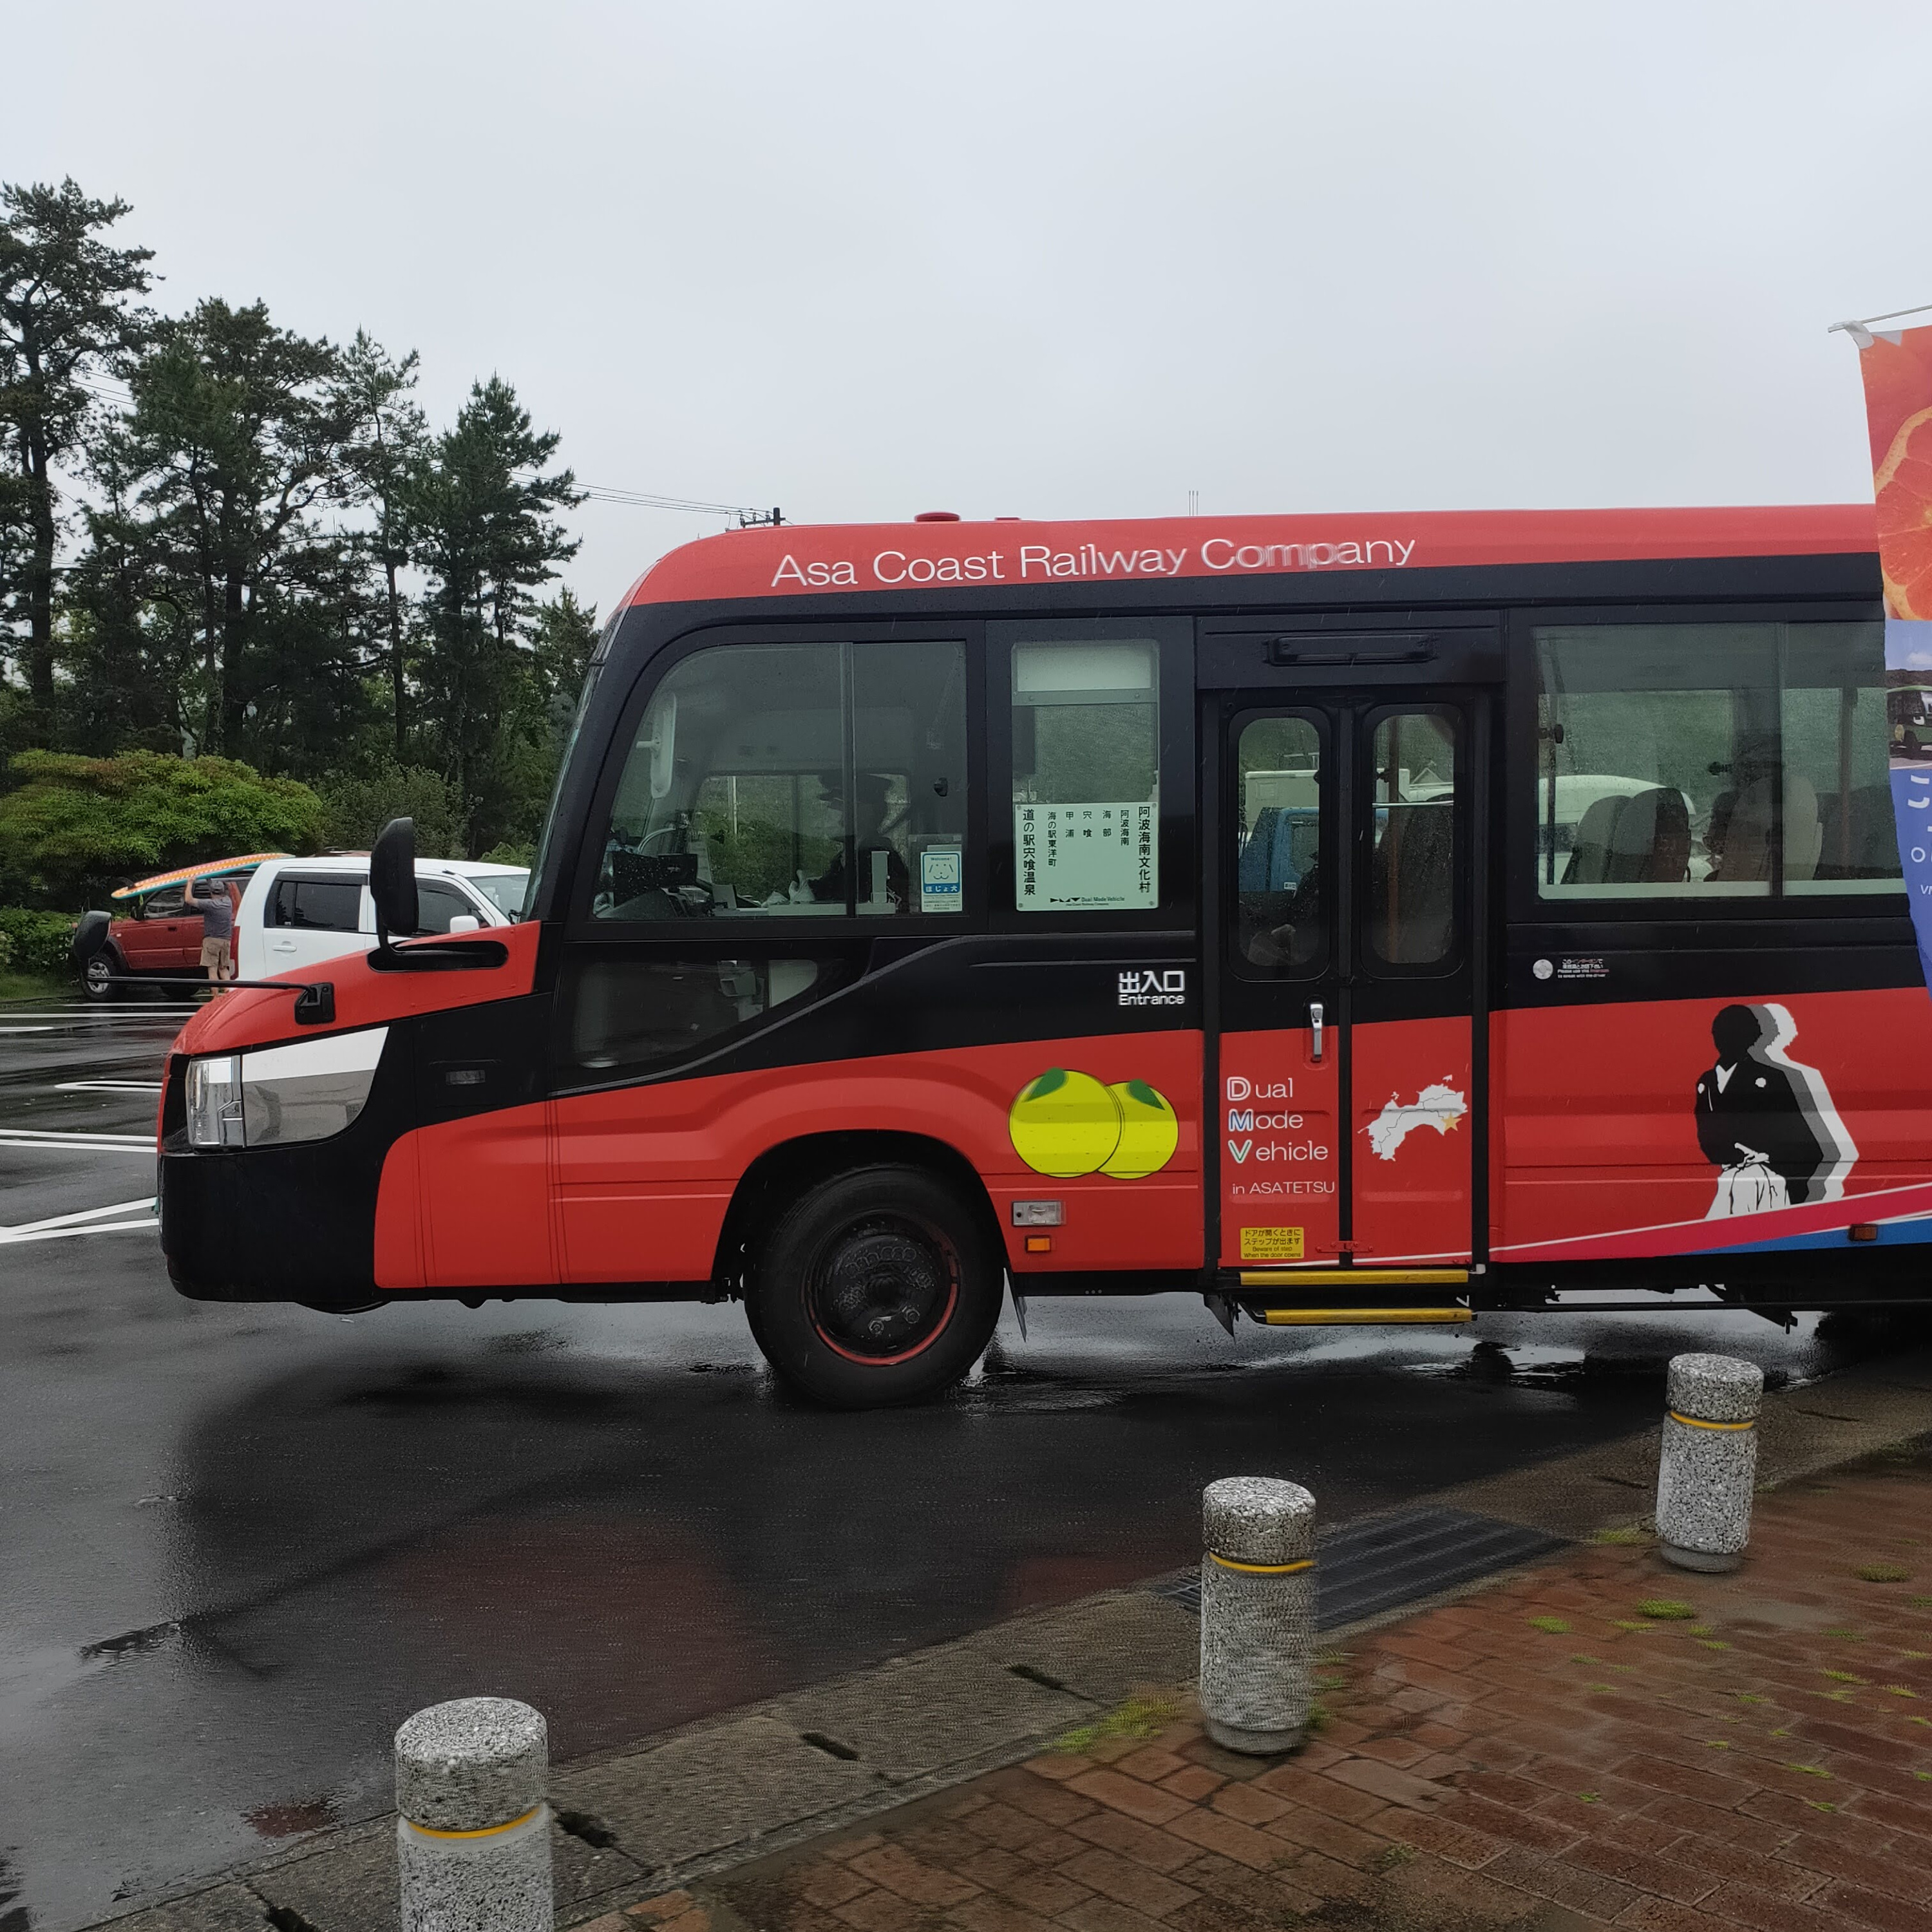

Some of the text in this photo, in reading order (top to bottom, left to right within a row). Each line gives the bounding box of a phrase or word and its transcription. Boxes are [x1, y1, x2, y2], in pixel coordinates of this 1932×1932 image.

[771, 538, 1416, 587] Asa Coast Railway Company
[1047, 811, 1057, 867] 海の駅東洋町
[1120, 810, 1130, 846] 阿波海南
[1023, 809, 1036, 896] 道の駅宍喰温泉
[1138, 806, 1151, 893] 阿波海南文化村
[1118, 971, 1185, 993] 出入口
[1118, 994, 1185, 1005] Entrance
[1227, 1076, 1293, 1101] Dual
[1229, 1108, 1303, 1132] Mode
[1227, 1139, 1329, 1164] Vehicle
[1232, 1181, 1335, 1195] in ASATETSU
